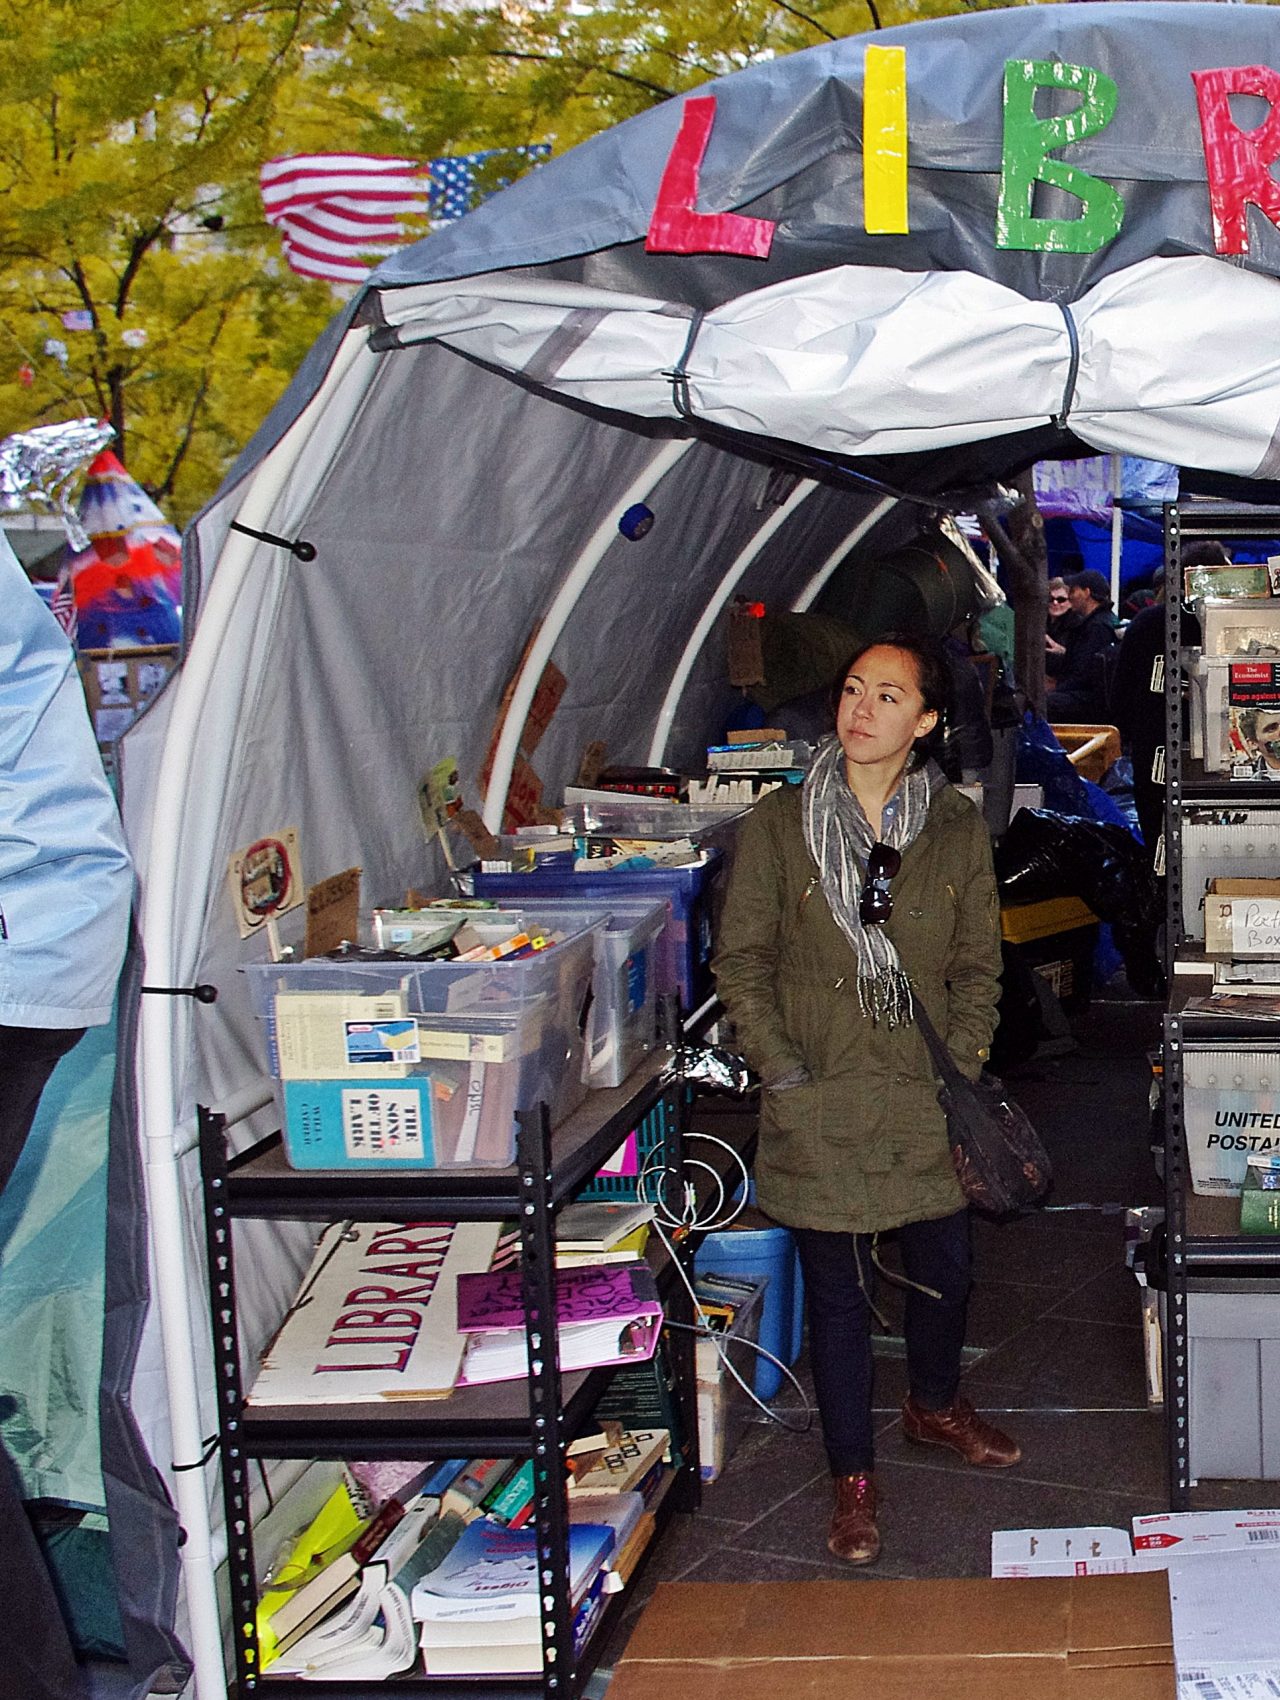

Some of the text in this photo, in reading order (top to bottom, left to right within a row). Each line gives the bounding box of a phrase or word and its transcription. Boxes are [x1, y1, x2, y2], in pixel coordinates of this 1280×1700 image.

[350, 1098, 366, 1148] LARK
[368, 1093, 385, 1153] OF THE
[386, 1102, 400, 1145] SONG
[404, 1104, 418, 1142] THE
[313, 1221, 457, 1375] LIBRARY
[475, 1580, 529, 1592] Digest
